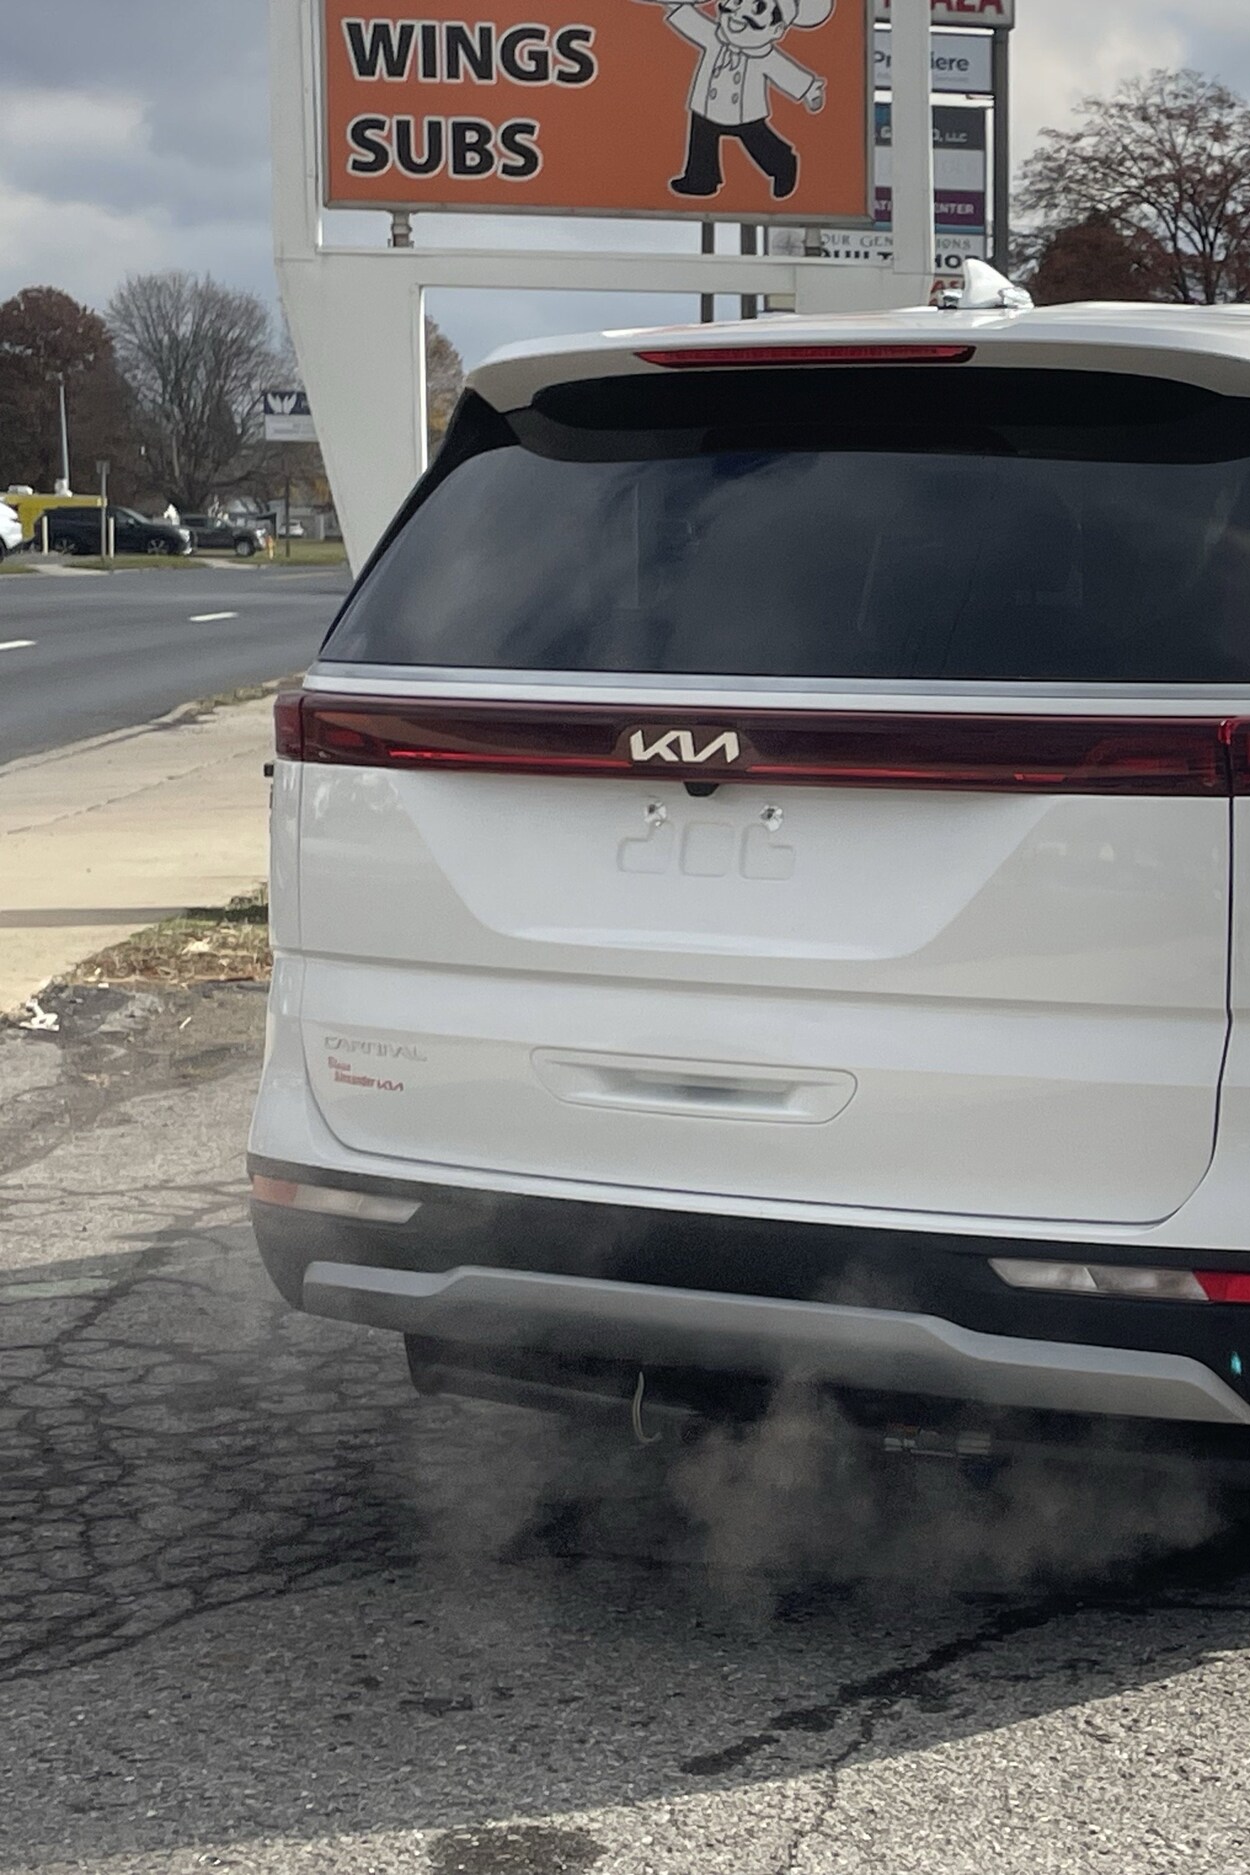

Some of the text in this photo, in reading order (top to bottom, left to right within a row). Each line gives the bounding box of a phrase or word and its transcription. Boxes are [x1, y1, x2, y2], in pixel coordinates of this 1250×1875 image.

[344, 20, 597, 86] WINGS
[348, 116, 541, 180] SUBS
[934, 202, 975, 215] ENTER
[629, 729, 740, 763] KIA
